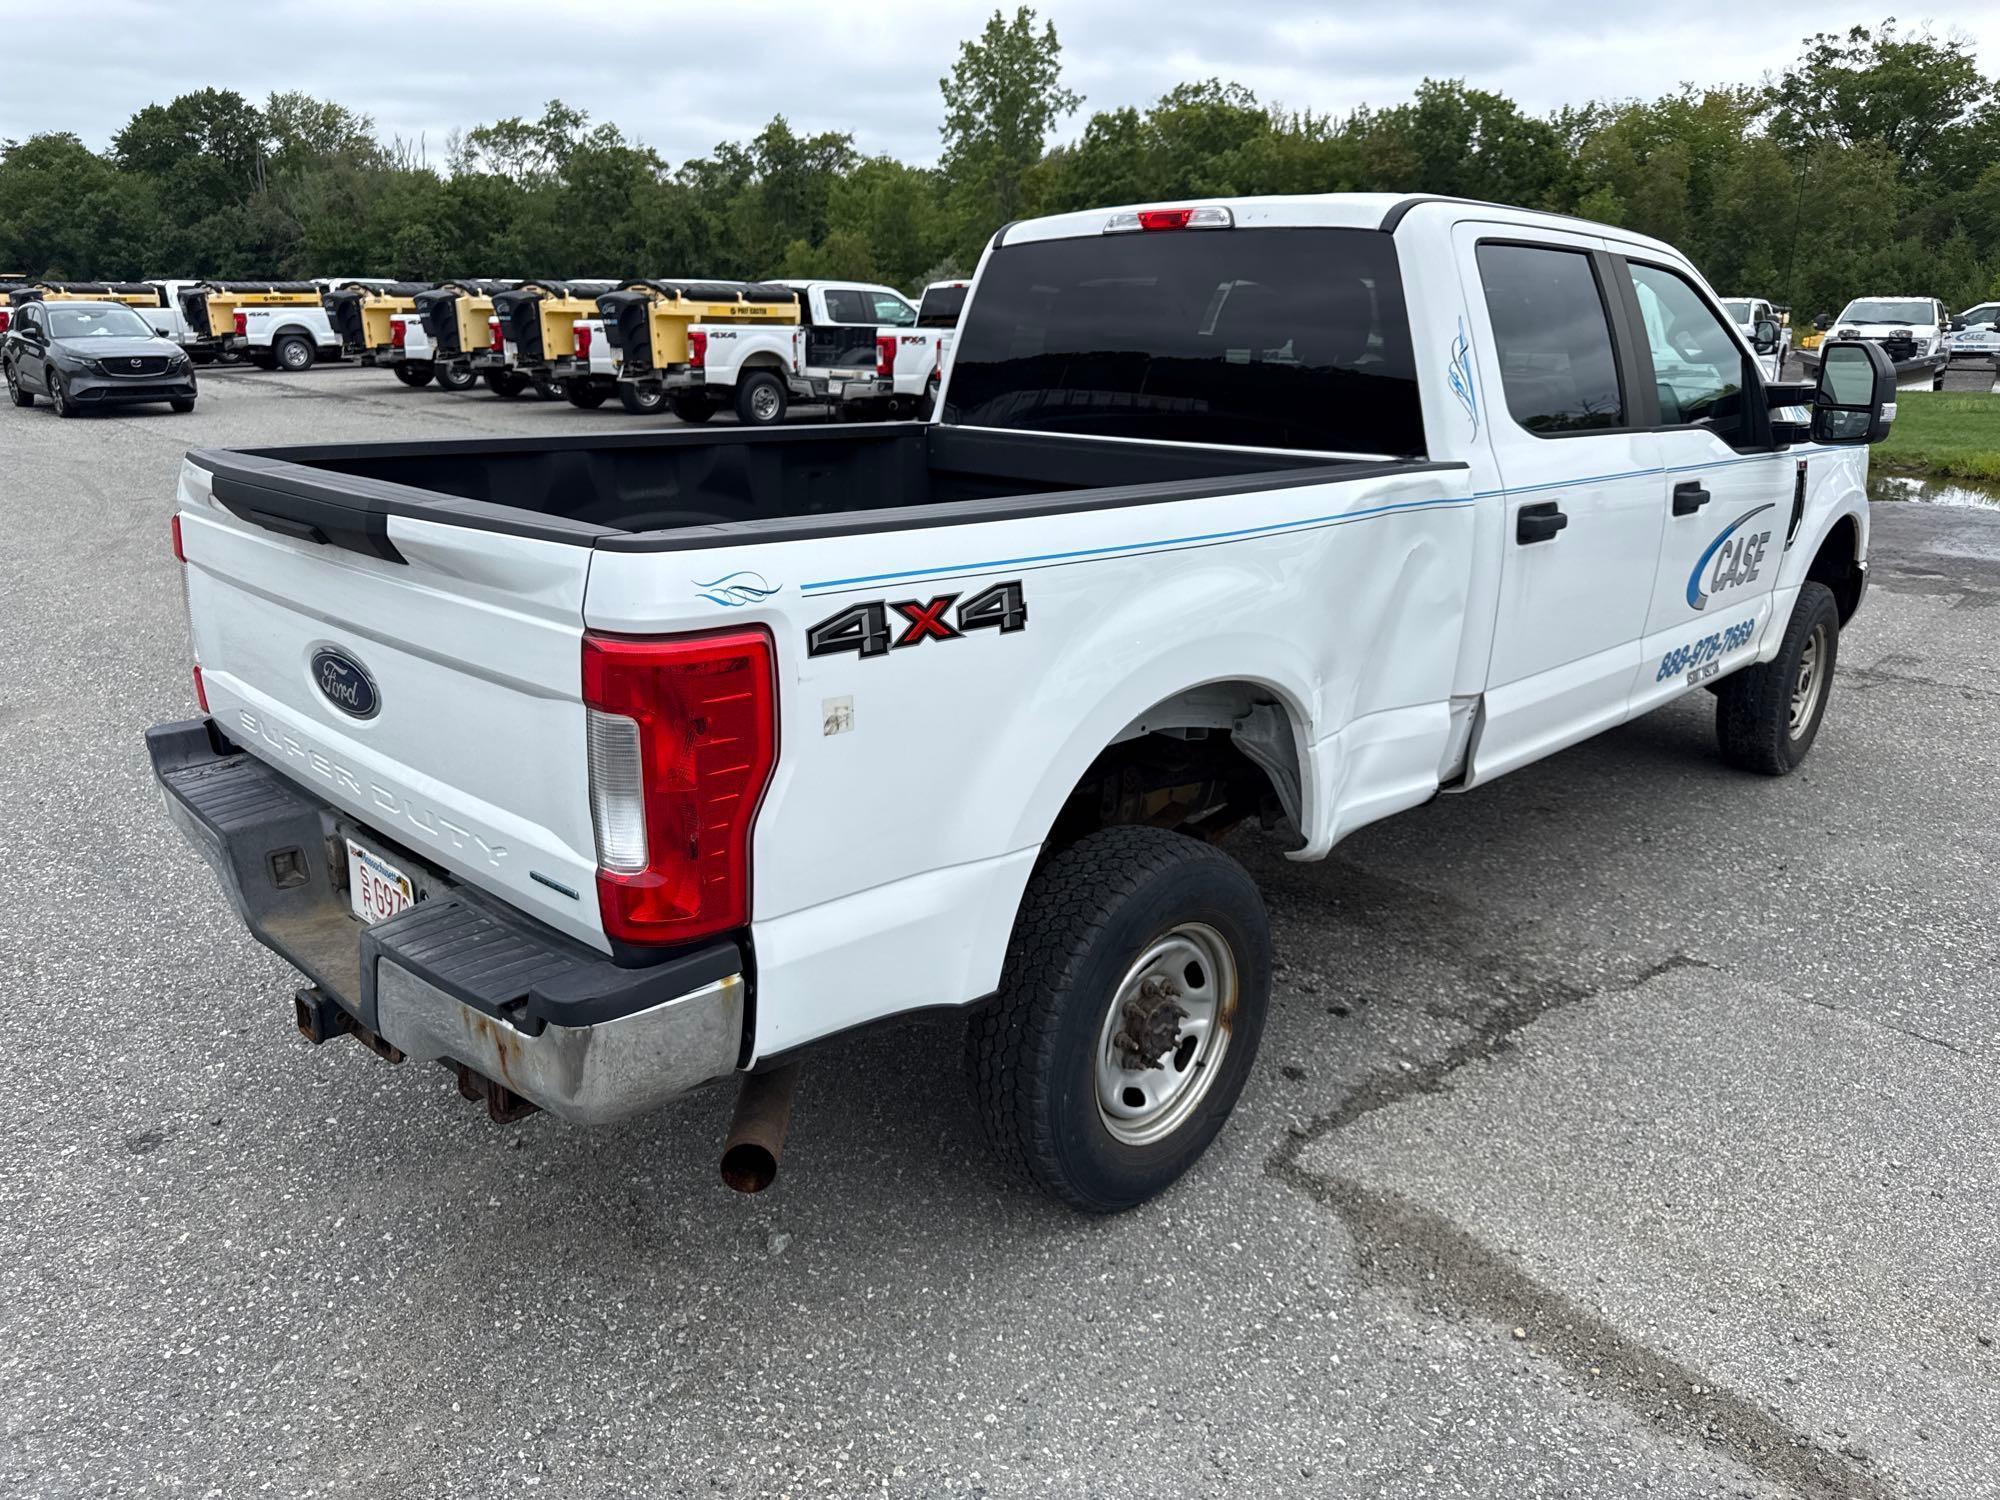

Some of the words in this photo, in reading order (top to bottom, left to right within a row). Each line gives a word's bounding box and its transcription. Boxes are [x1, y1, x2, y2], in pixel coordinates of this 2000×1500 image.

[1711, 531, 1772, 594] CASE
[1655, 618, 1755, 682] 888-978-7669
[321, 660, 359, 706] Ford
[239, 709, 362, 795] SUPER
[369, 782, 508, 867] DUTY
